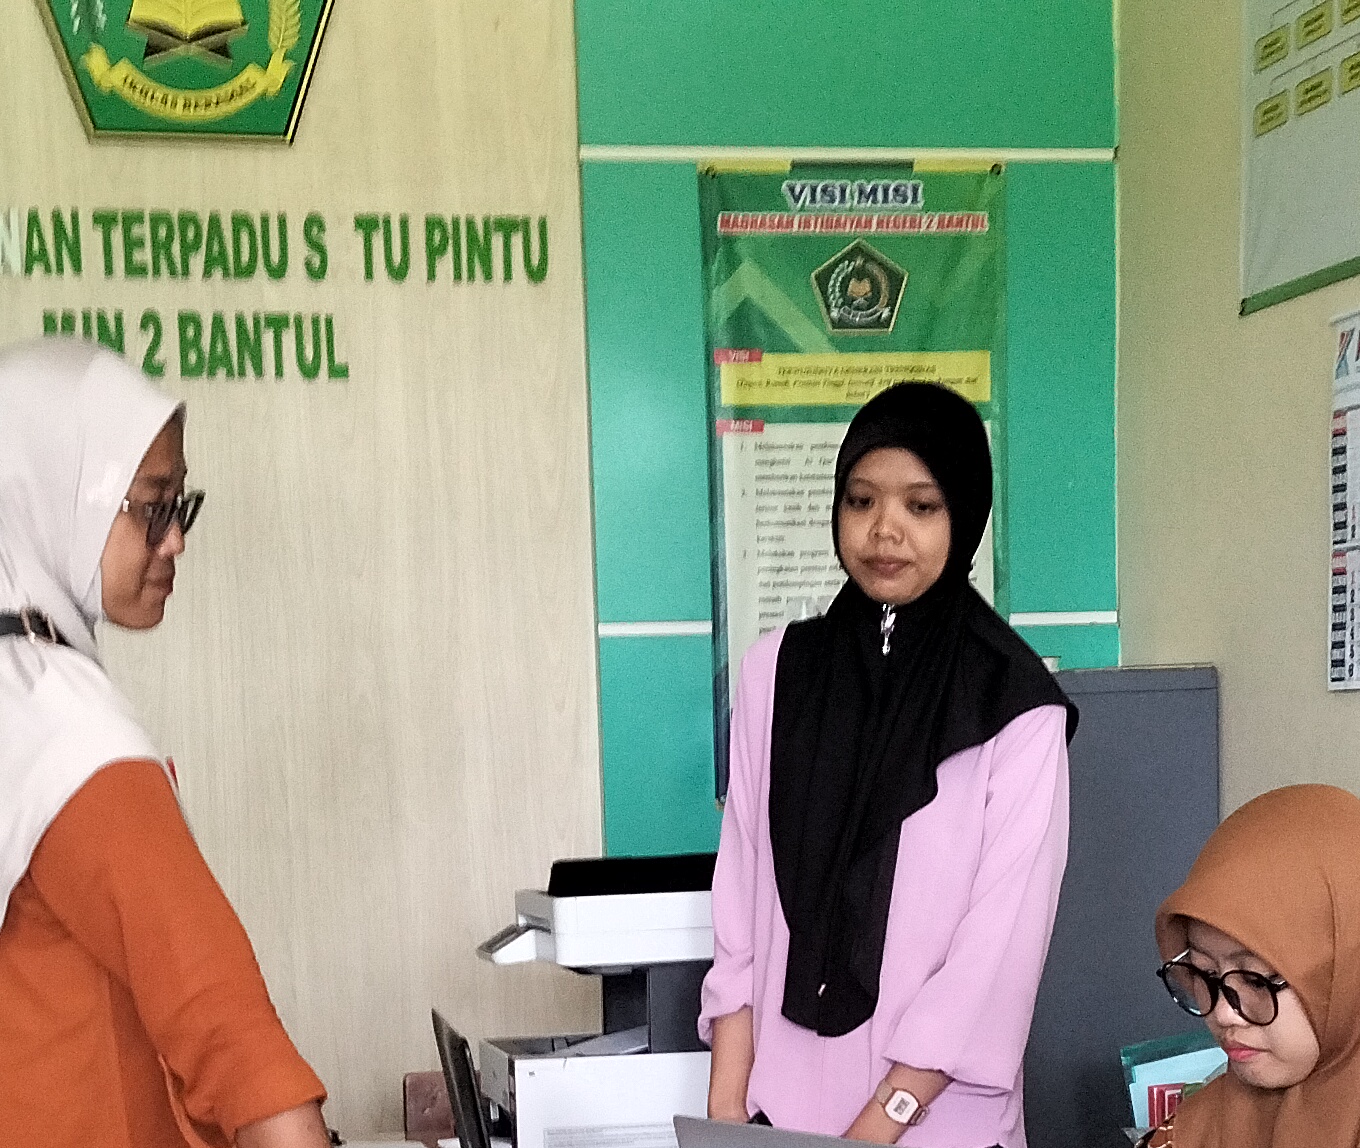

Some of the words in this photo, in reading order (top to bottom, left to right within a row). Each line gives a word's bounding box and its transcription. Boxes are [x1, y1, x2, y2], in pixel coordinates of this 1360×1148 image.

[782, 181, 850, 208] VISI
[854, 181, 923, 207] MISI
[92, 206, 289, 281] TERPADU
[424, 212, 548, 285] PINTU
[140, 307, 166, 379] 2
[177, 309, 350, 382] BANTUL
